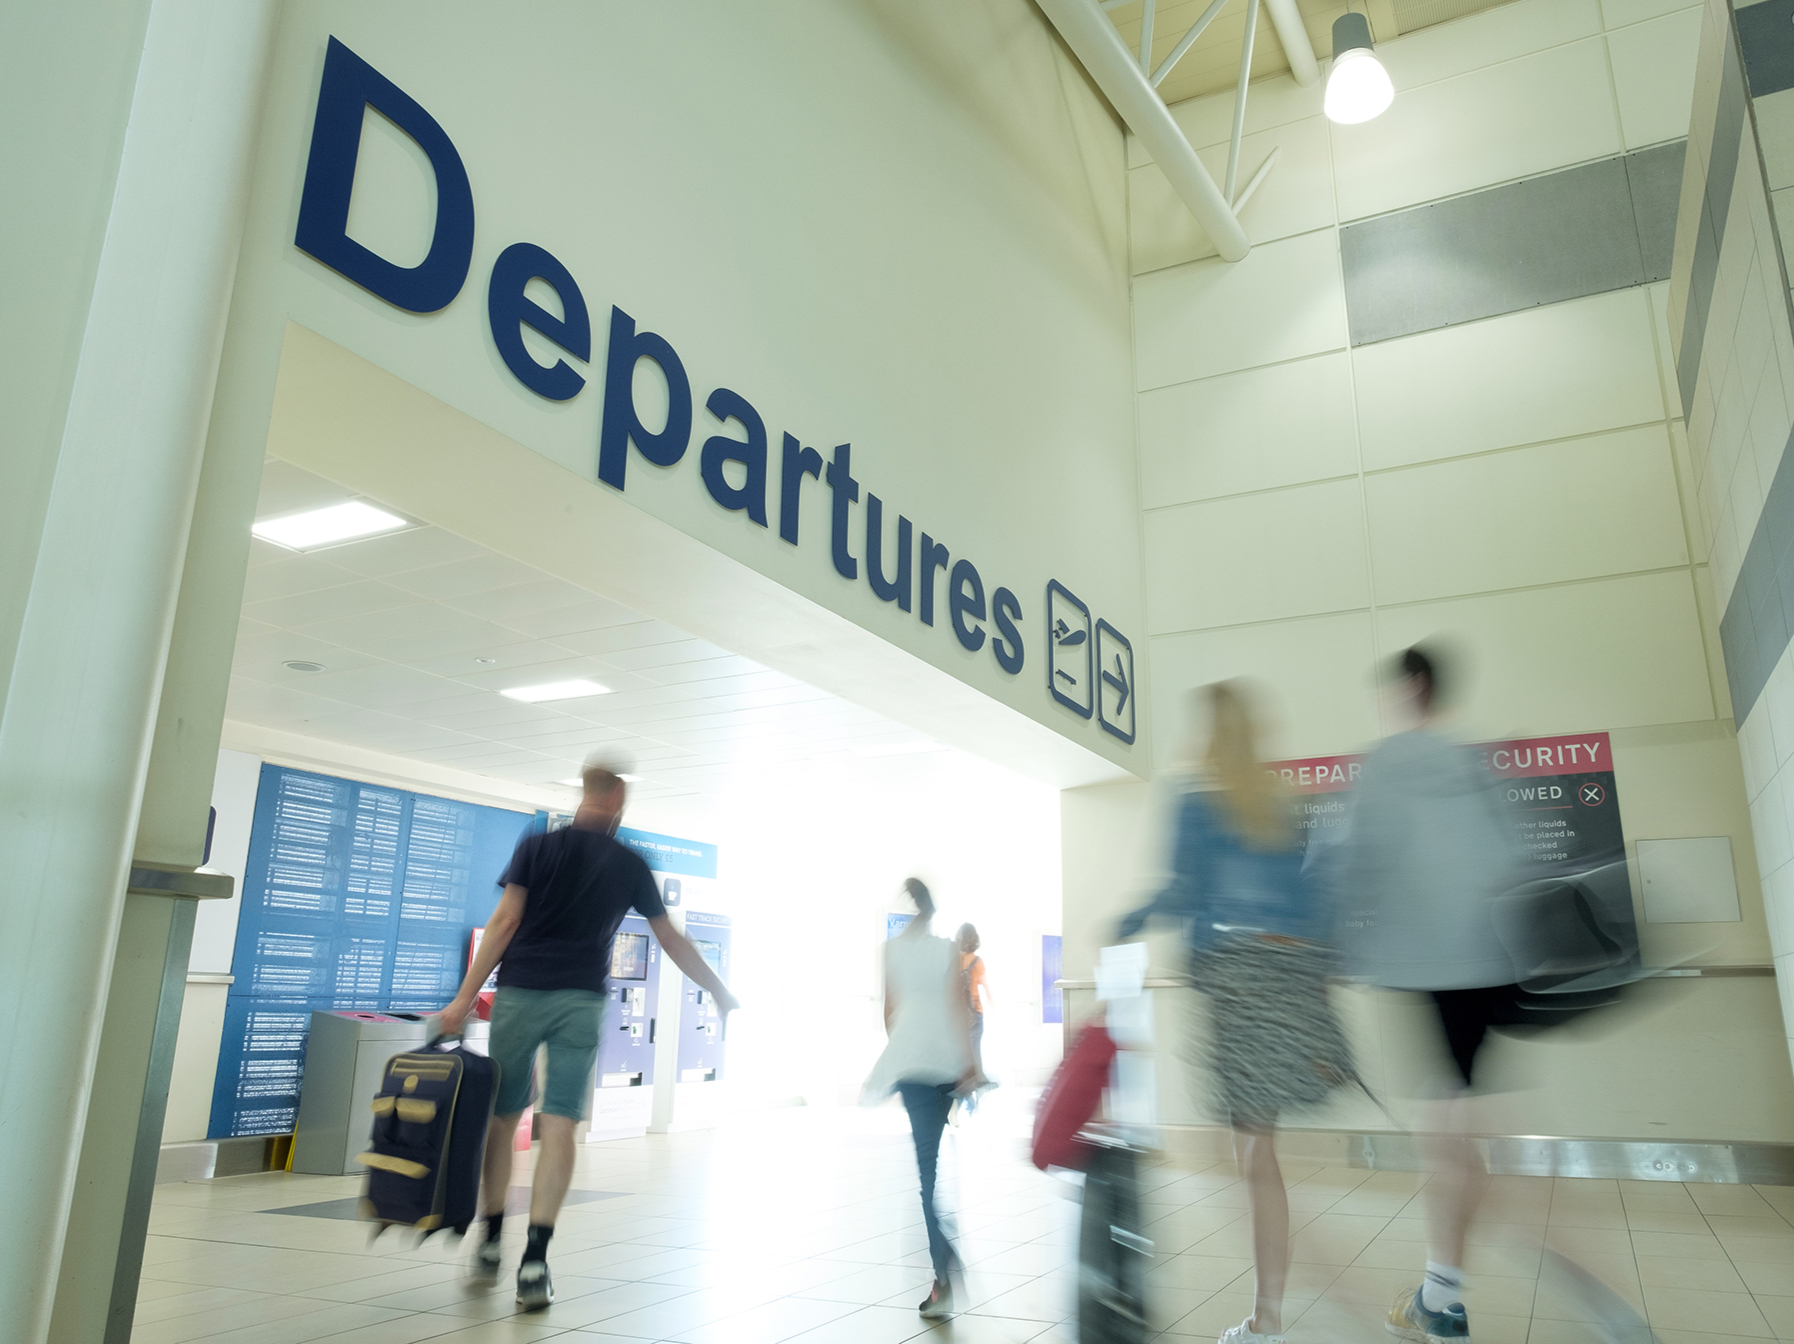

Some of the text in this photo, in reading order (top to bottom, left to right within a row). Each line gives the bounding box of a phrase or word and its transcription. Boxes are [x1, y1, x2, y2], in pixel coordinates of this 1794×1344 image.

[294, 33, 1024, 675] Departures
[1304, 802, 1345, 815] liquids
[1294, 818, 1318, 830] and
[1538, 820, 1567, 828] liquids
[1536, 830, 1565, 840] placed
[1523, 841, 1558, 849] checked
[644, 850, 664, 862] ONLY
[1533, 853, 1568, 861] luggage
[1345, 919, 1364, 928] baby
